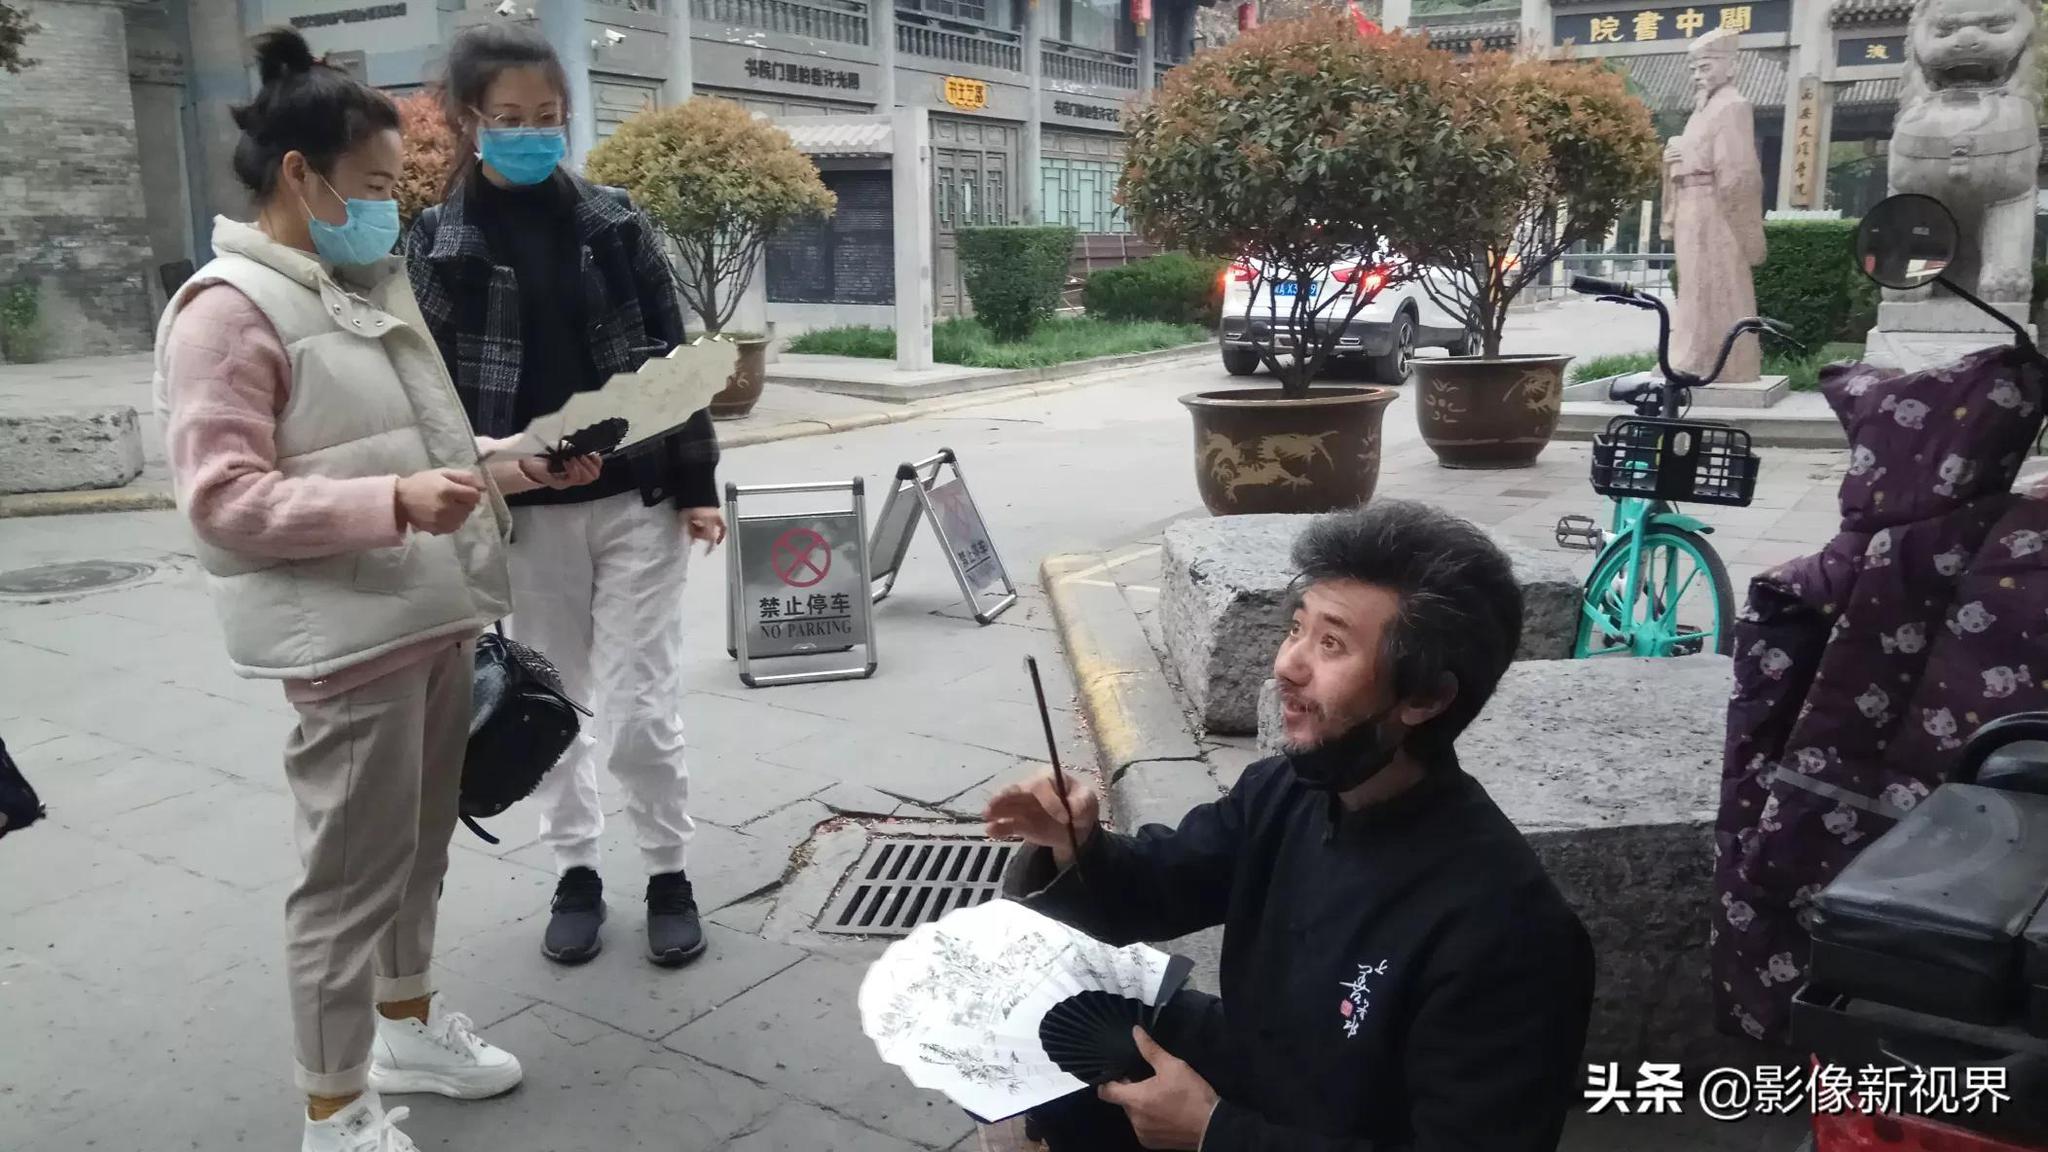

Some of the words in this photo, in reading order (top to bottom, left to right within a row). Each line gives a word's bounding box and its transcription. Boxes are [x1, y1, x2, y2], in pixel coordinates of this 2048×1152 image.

[759, 593, 850, 618] 禁止停车
[761, 625, 781, 639] NO
[788, 620, 851, 637] PARKING
